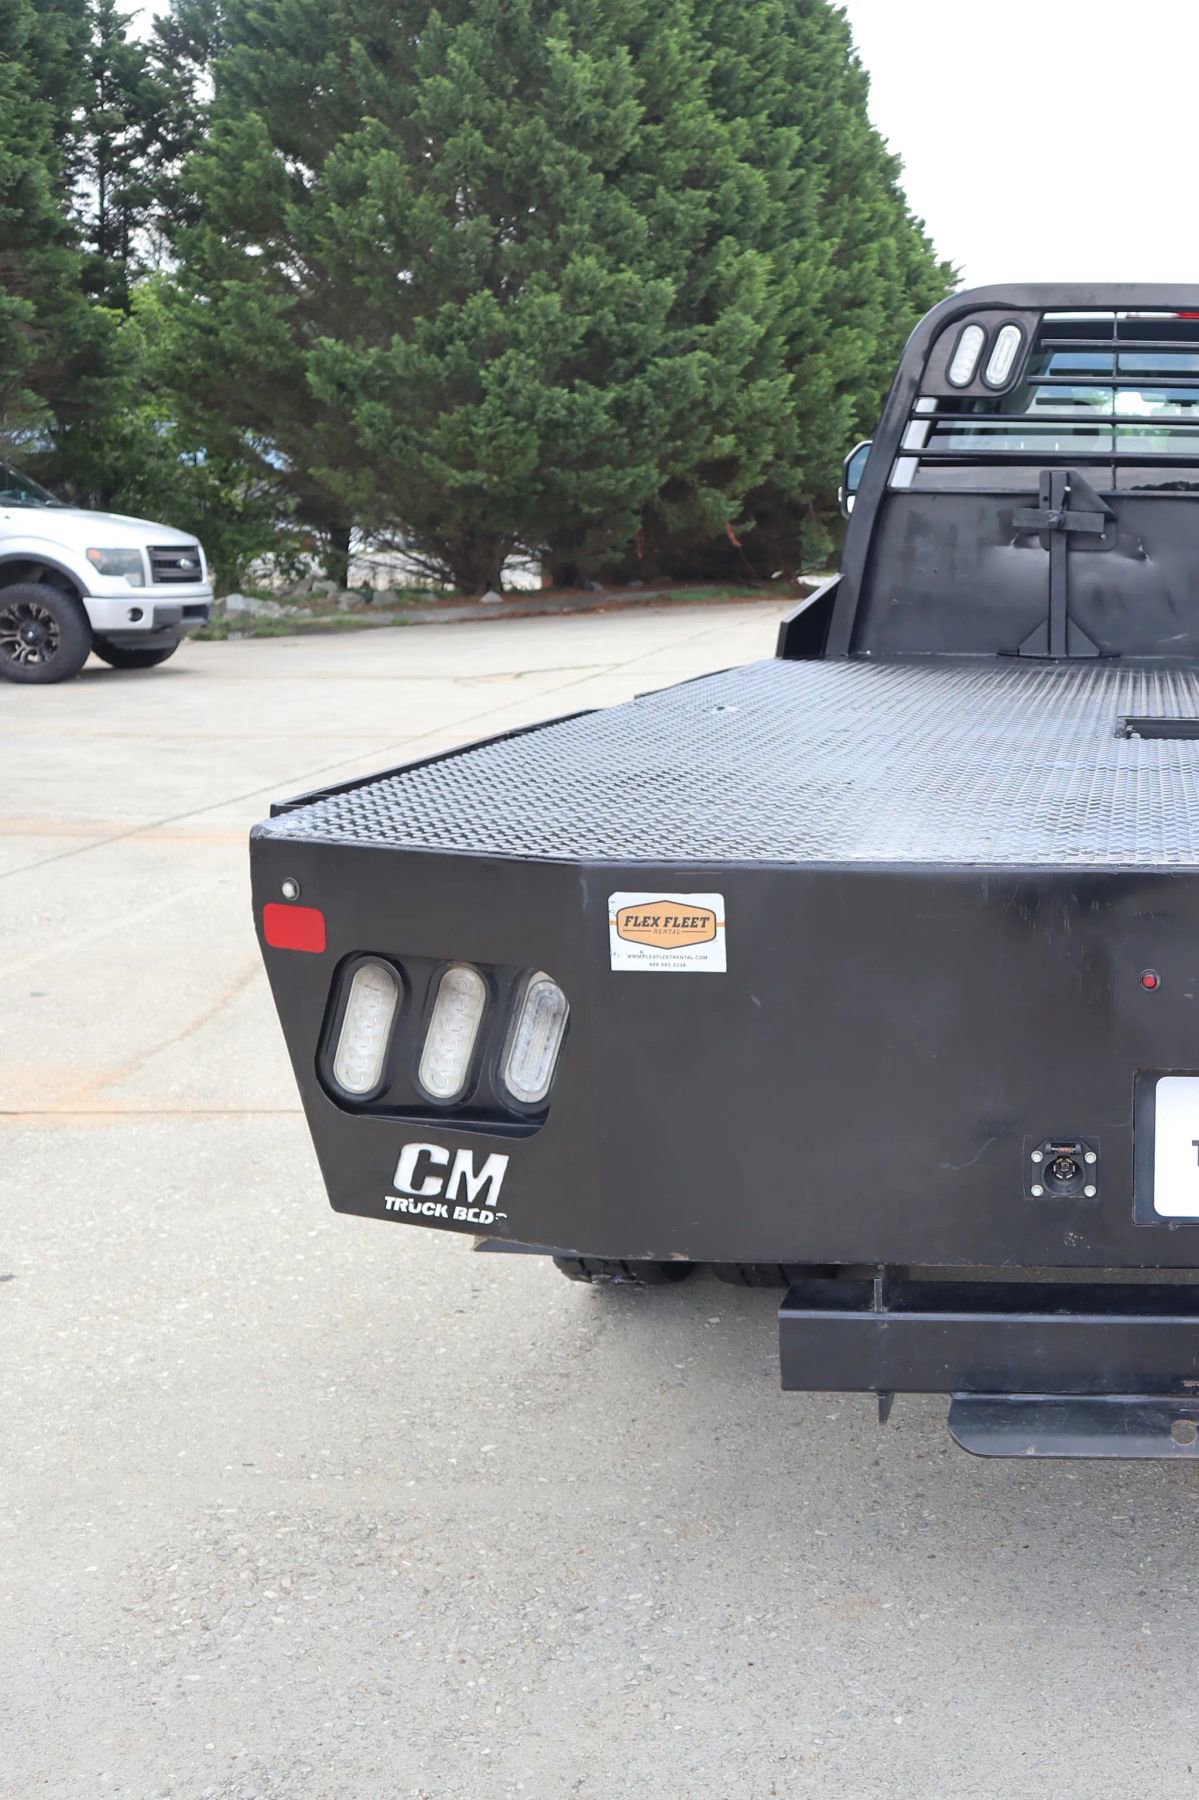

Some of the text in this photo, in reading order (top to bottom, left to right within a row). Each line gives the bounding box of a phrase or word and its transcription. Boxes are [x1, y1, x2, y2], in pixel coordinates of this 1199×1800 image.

[624, 915, 710, 928] FLEX FLEET
[393, 1142, 510, 1206] CM
[384, 1196, 449, 1218] TRUCK
